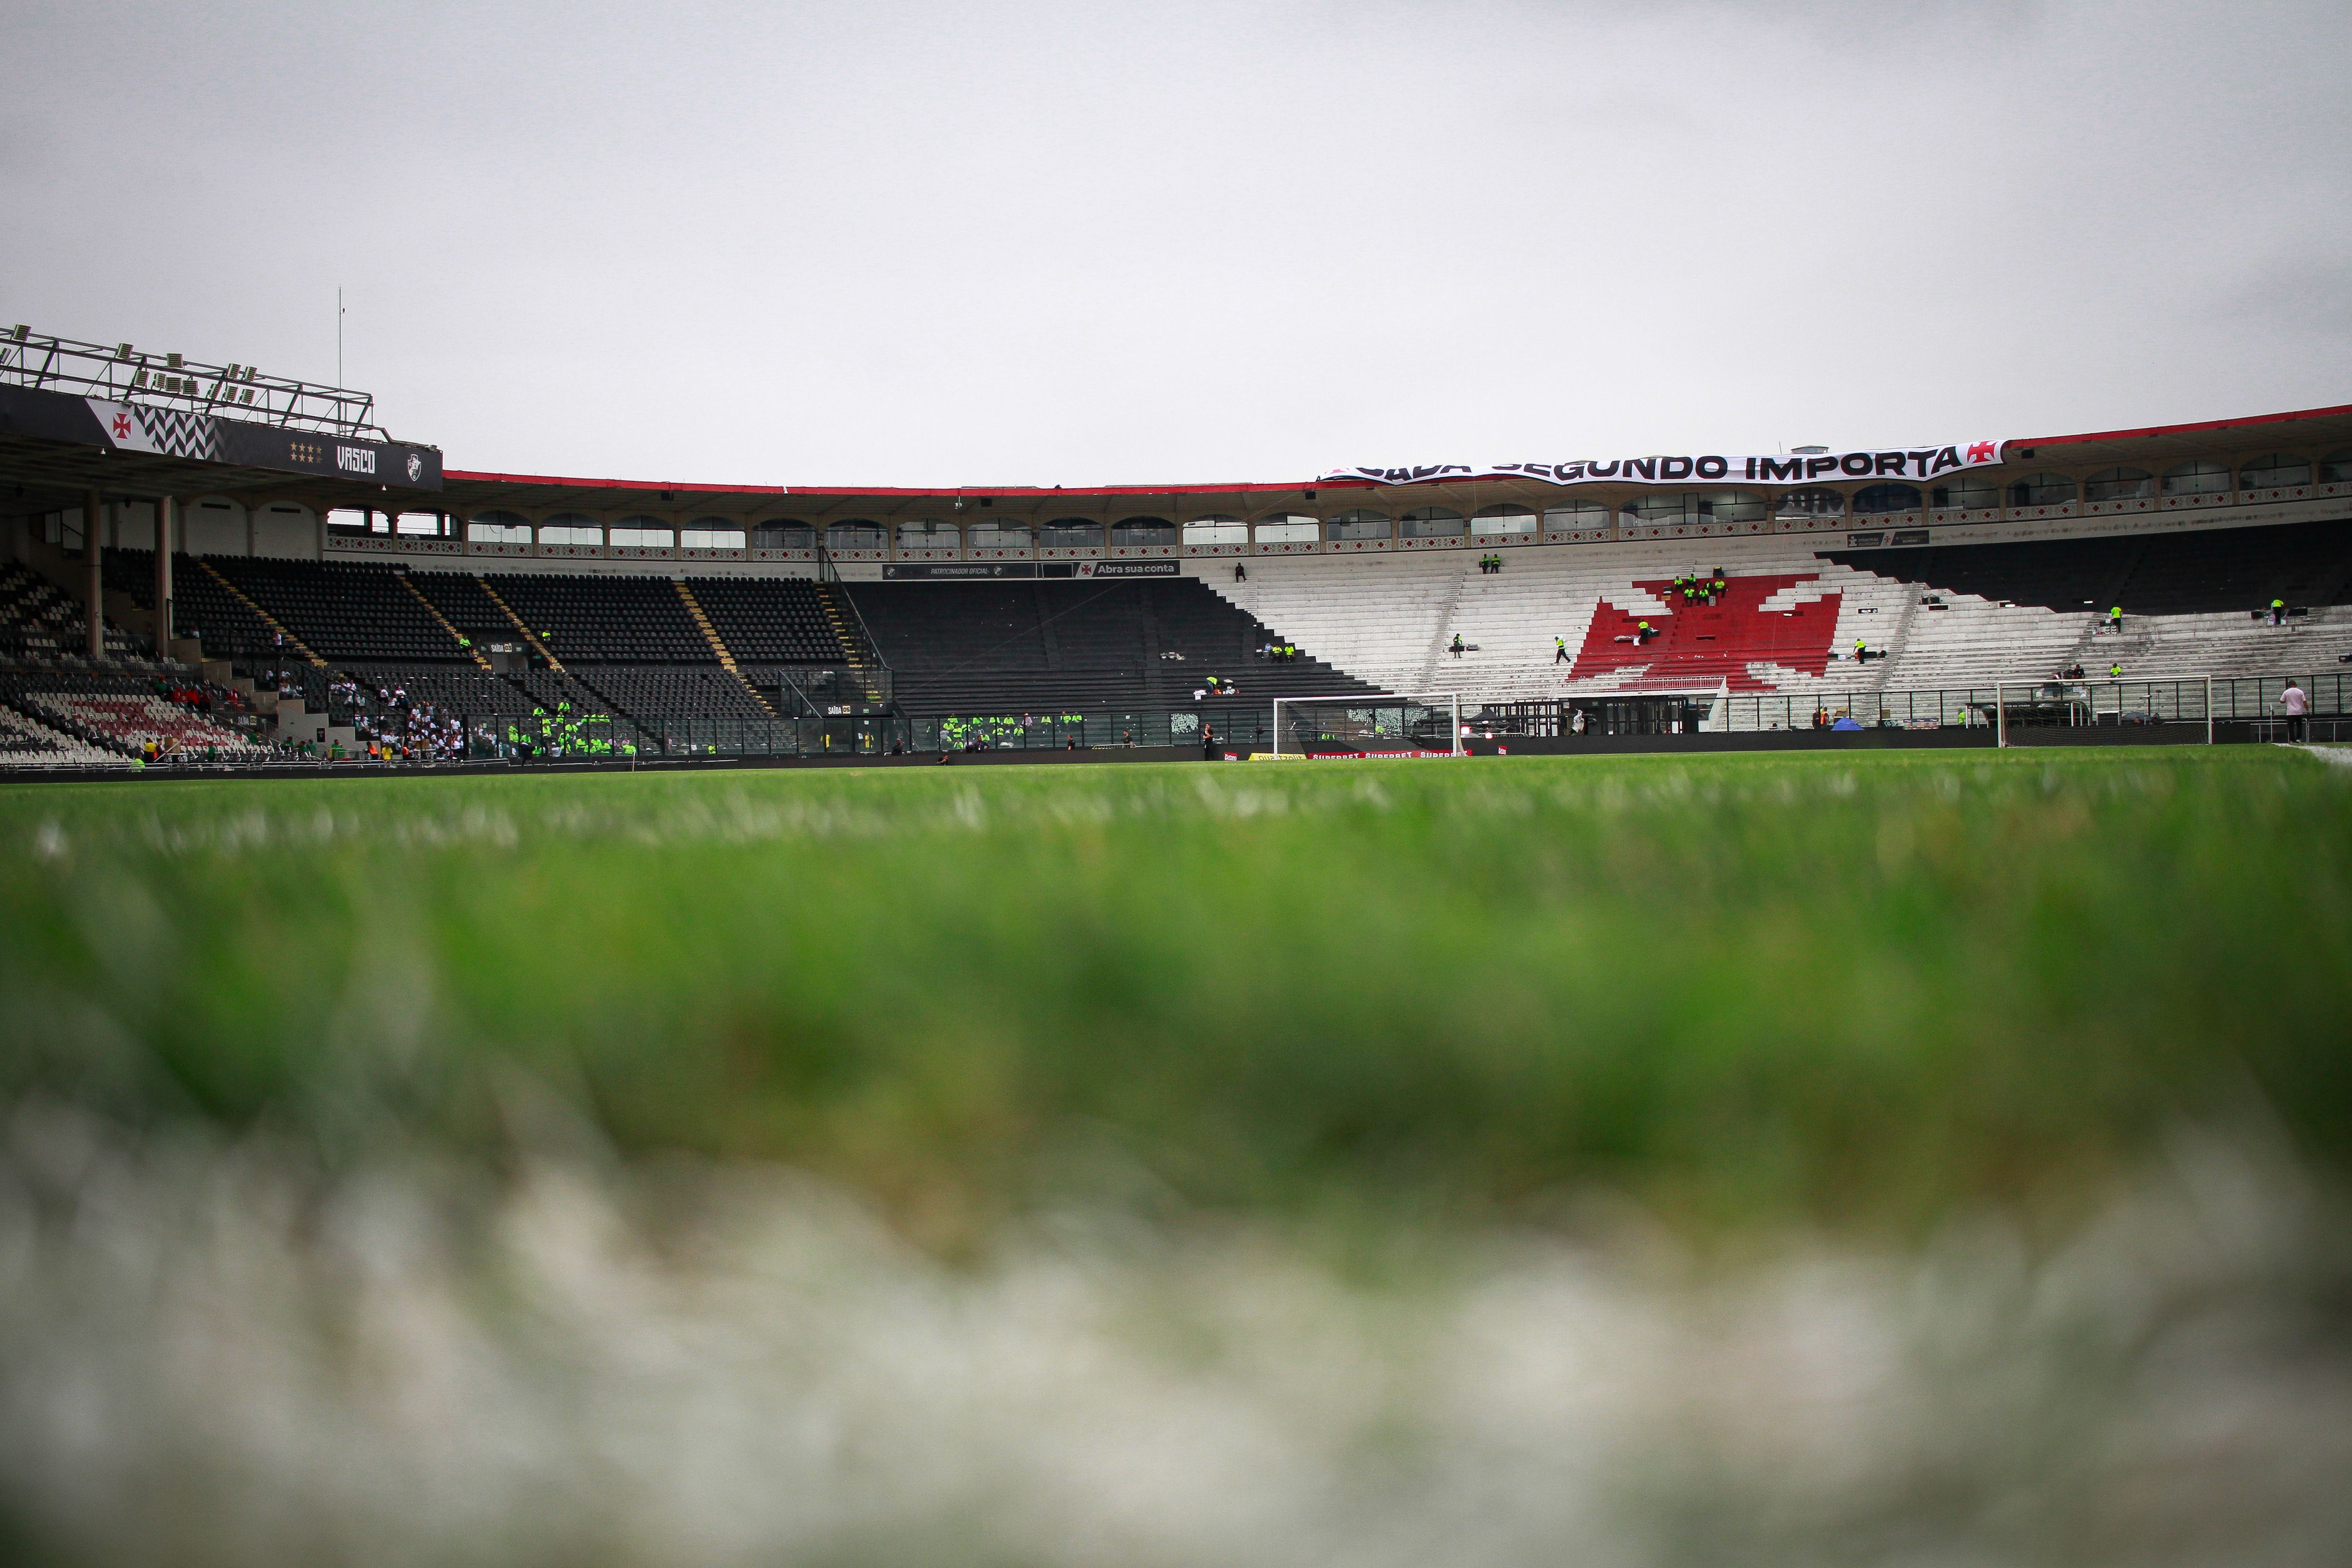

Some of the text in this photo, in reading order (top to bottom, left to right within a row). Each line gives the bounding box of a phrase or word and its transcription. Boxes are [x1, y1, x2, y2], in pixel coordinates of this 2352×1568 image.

[337, 446, 375, 474] VASCO
[1491, 456, 1728, 481] EGUNDO
[1746, 446, 1963, 480] IMPORTA
[1098, 565, 1123, 574] Abra
[828, 706, 842, 715] SAÍDA
